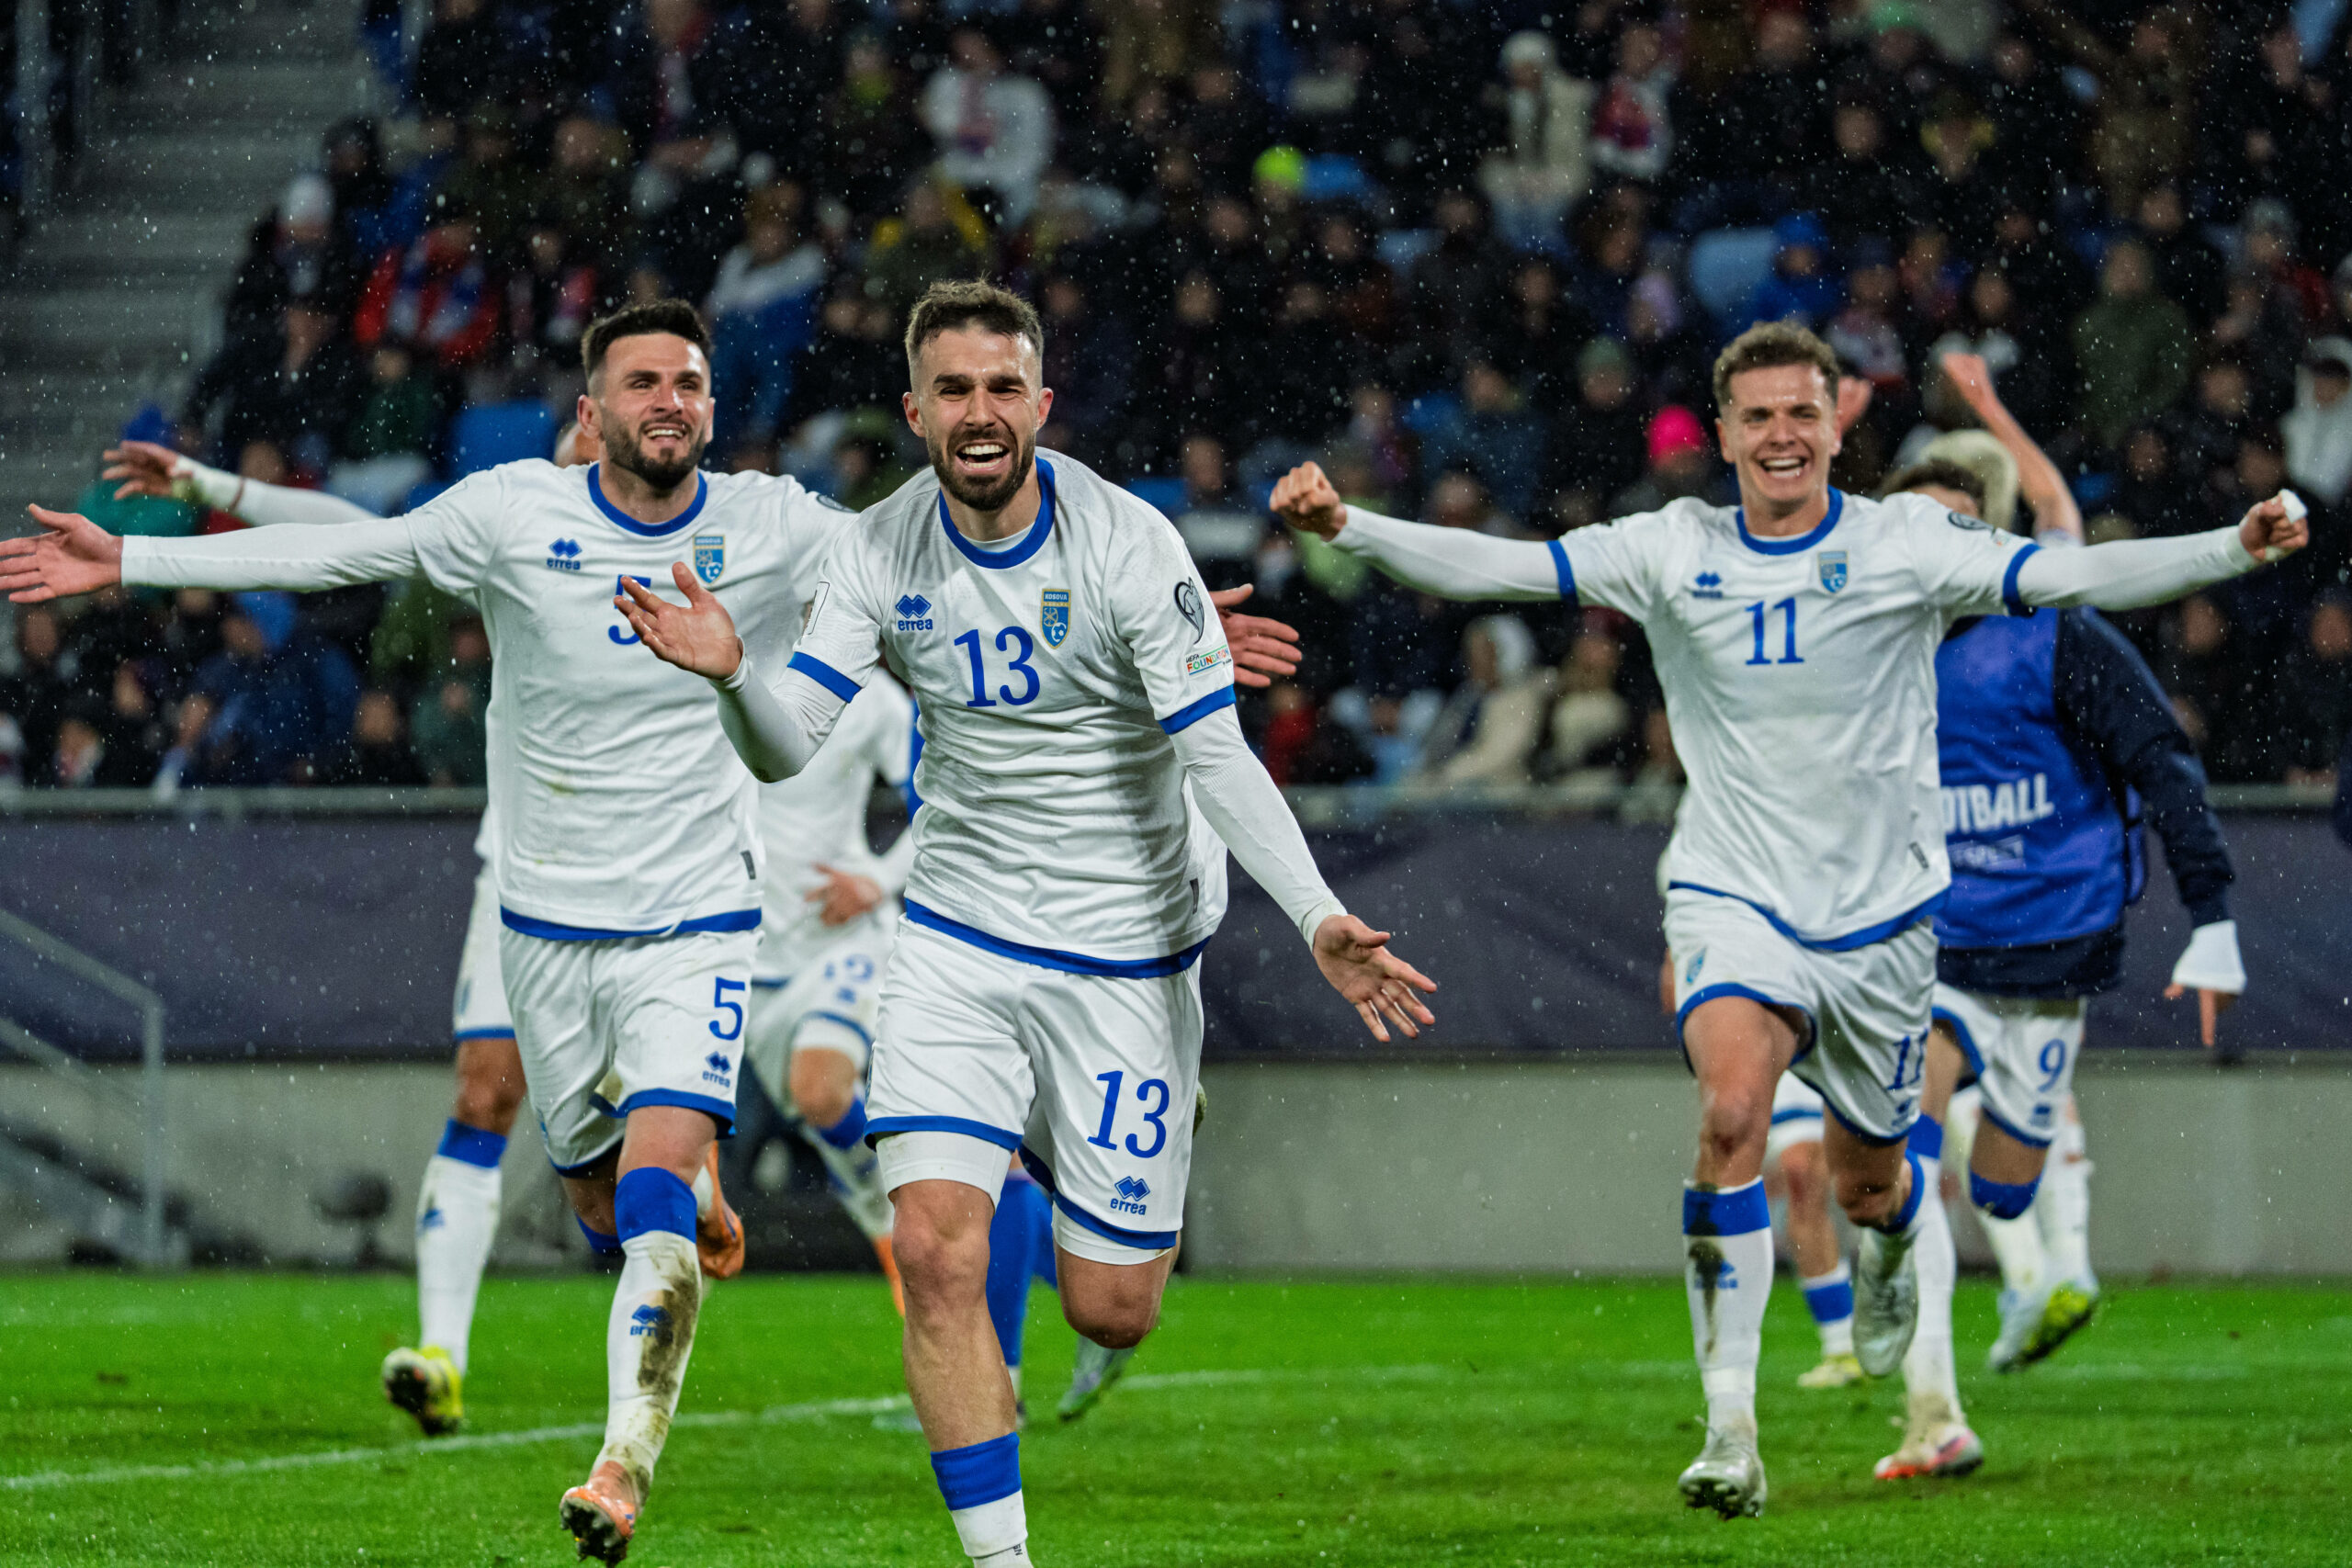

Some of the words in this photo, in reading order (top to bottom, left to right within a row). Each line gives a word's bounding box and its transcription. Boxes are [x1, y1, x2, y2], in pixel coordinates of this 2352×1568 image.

[547, 557, 581, 570] errea
[898, 617, 933, 631] errea
[1745, 597, 1804, 665] 11
[954, 626, 1040, 707] 13
[1185, 653, 1200, 663] UEFA
[1940, 773, 2055, 836] OTBALL
[708, 976, 745, 1041] 5
[702, 1069, 730, 1088] errea
[1887, 1028, 1928, 1090] 11
[2039, 1038, 2066, 1093] 9
[1087, 1070, 1170, 1158] 13
[1110, 1198, 1147, 1215] errea
